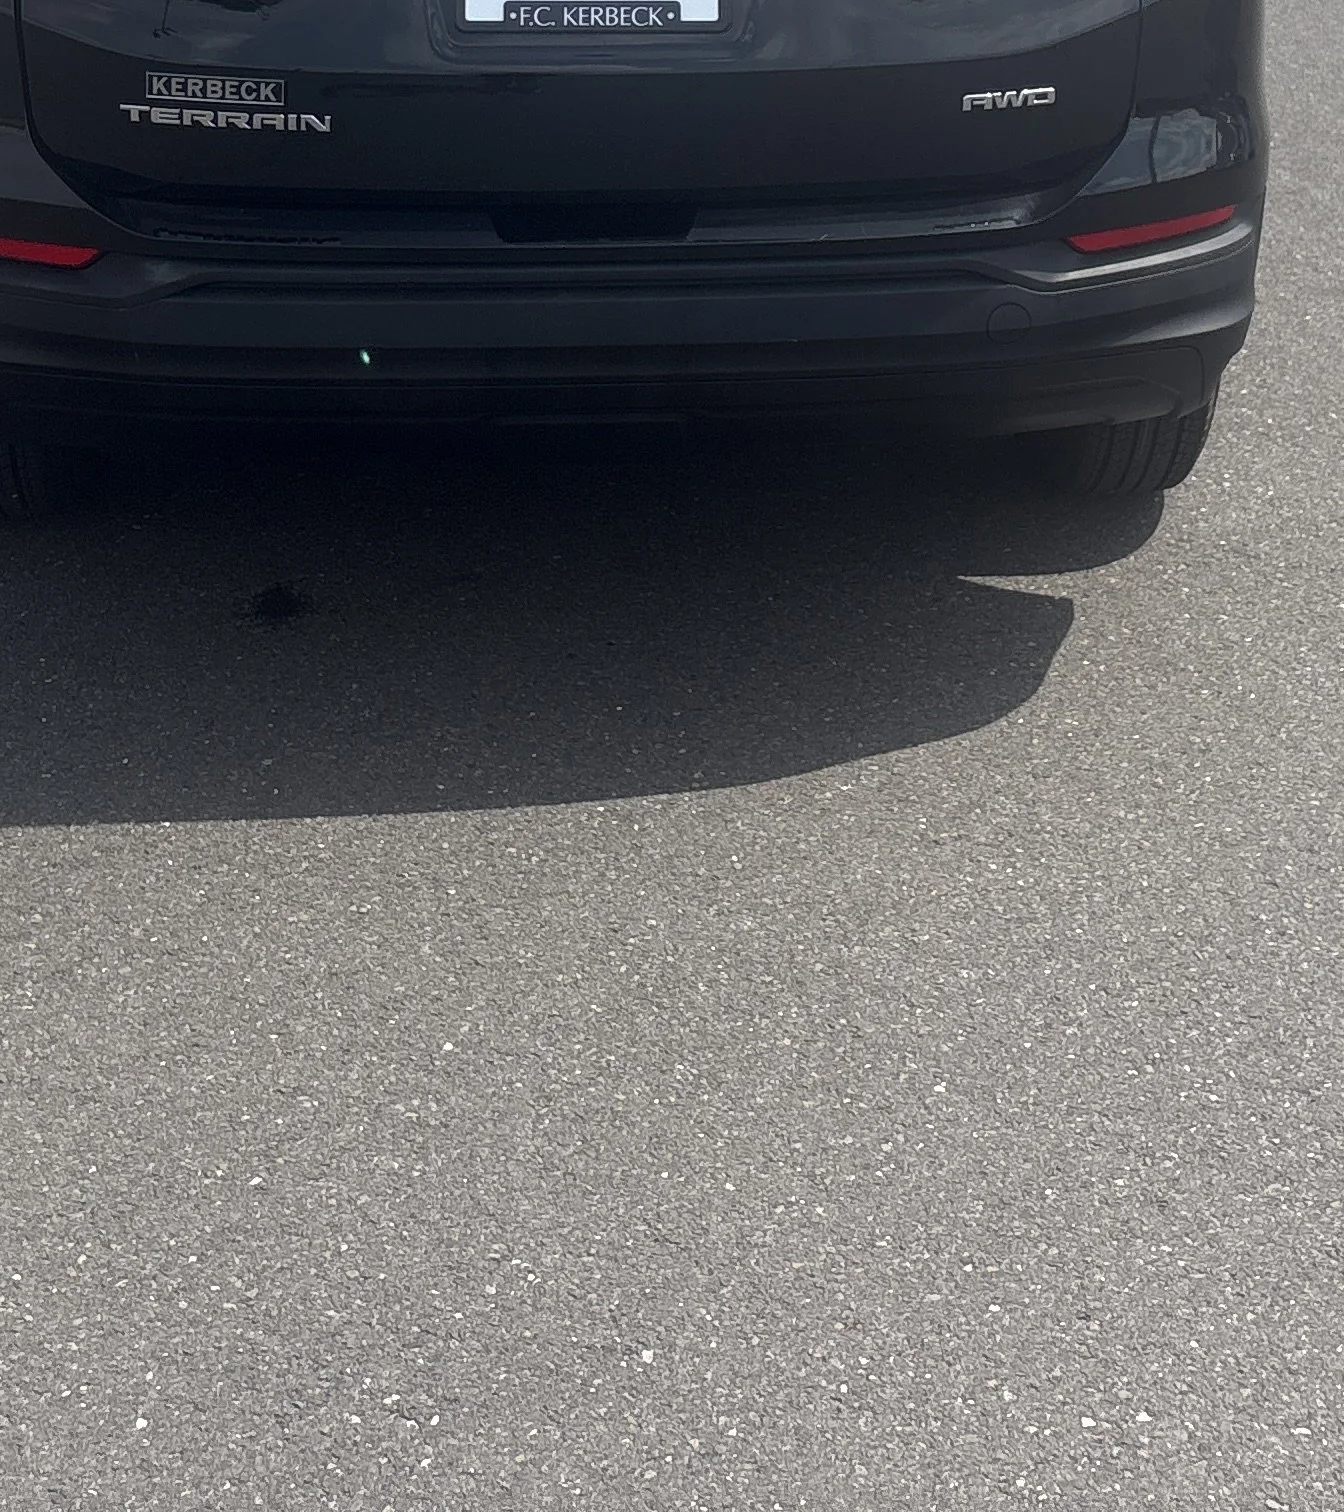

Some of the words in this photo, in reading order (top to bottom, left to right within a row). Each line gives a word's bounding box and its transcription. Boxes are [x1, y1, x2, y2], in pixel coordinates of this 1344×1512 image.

[519, 6, 556, 27] F.C.
[563, 7, 664, 27] KERBECK
[151, 76, 278, 102] KERBECK
[962, 87, 1056, 111] AWD
[119, 103, 332, 133] TERRAIN
